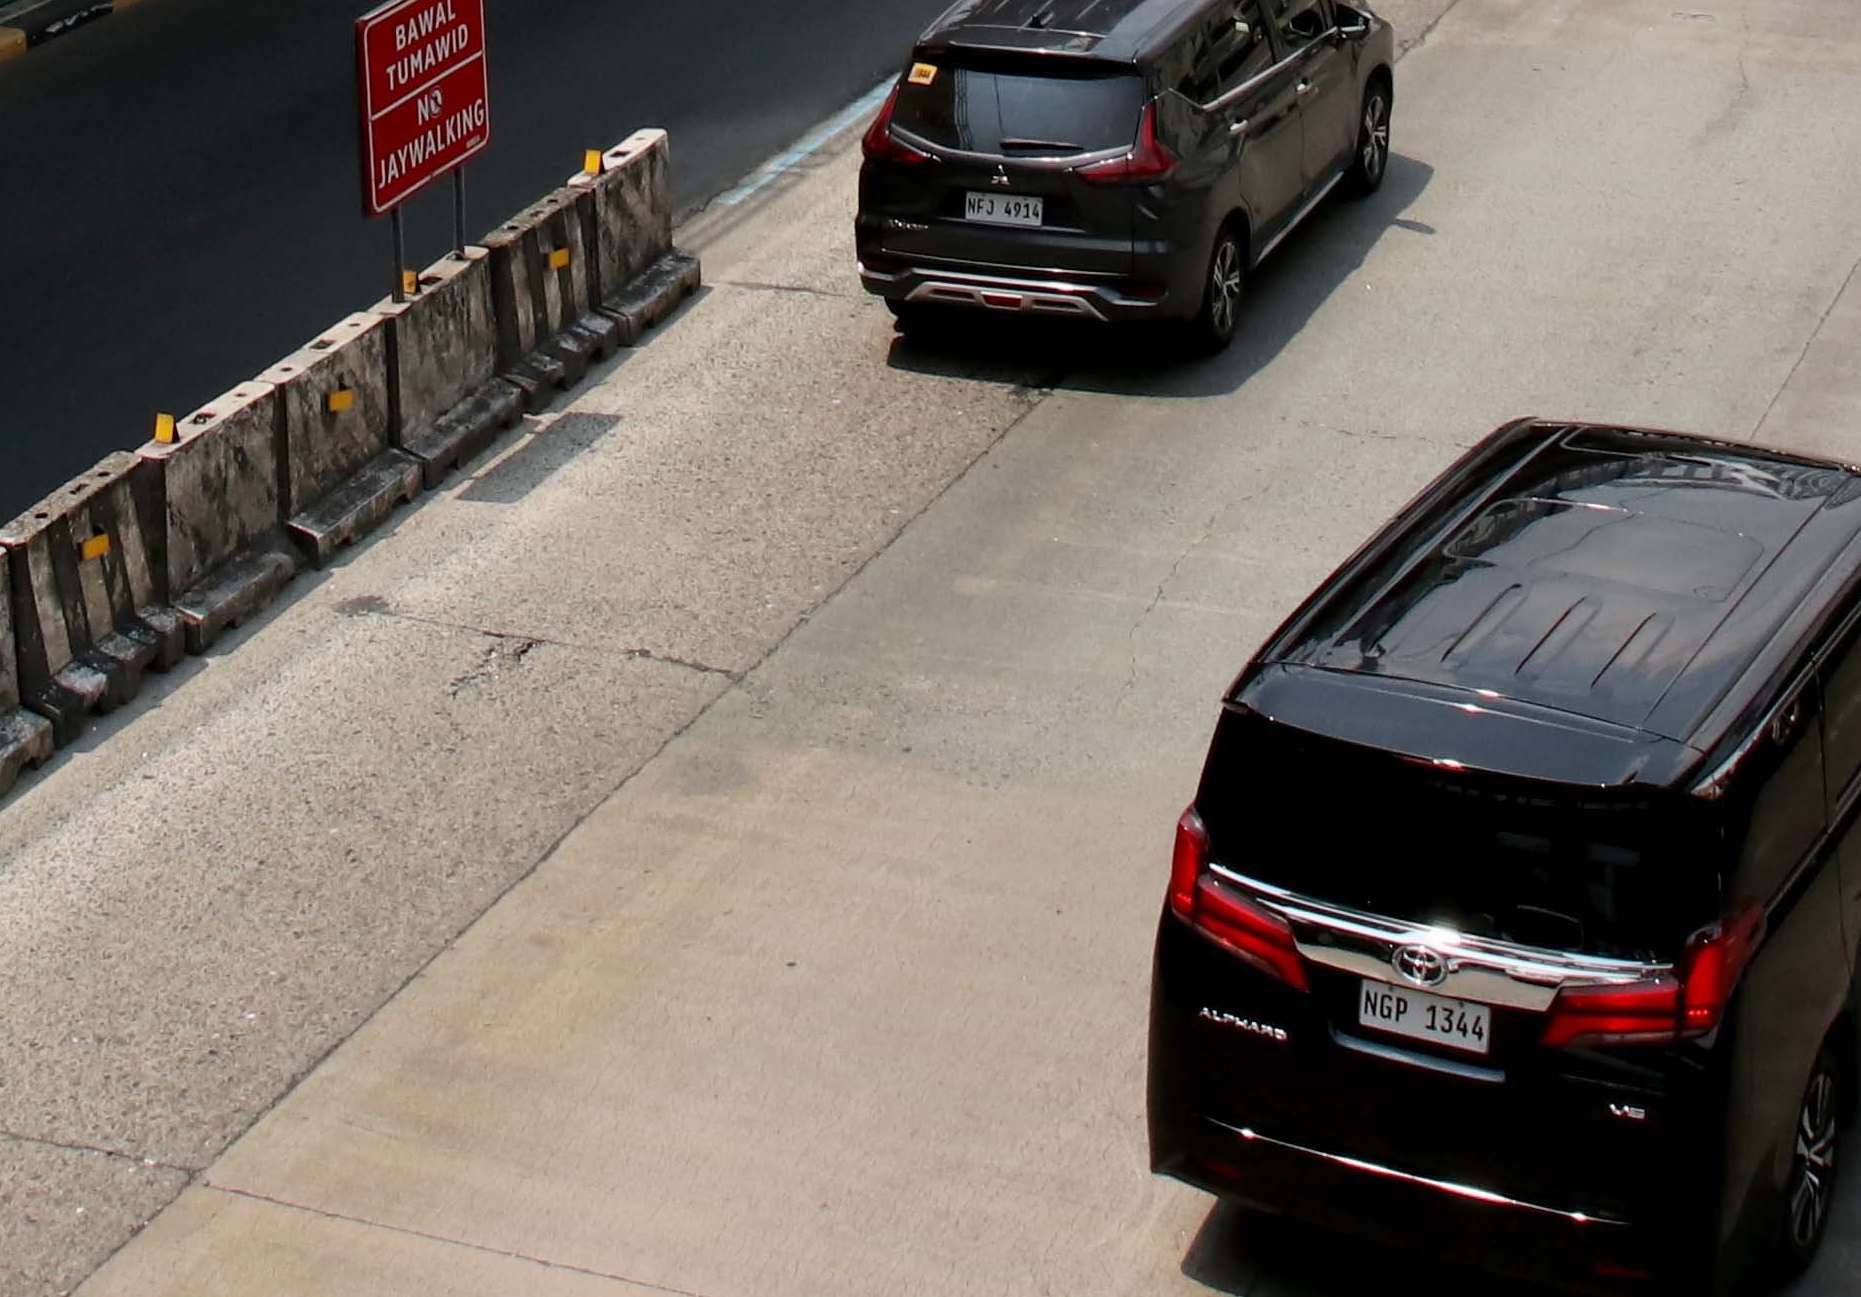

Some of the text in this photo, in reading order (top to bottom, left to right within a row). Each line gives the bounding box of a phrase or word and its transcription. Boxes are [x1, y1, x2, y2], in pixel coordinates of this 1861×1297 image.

[386, 24, 468, 91] TUMAWID
[417, 89, 443, 126] NO
[379, 98, 485, 189] JAYWALKING
[967, 196, 1040, 218] NFJ 4914
[1363, 990, 1485, 1043] NGP 1344
